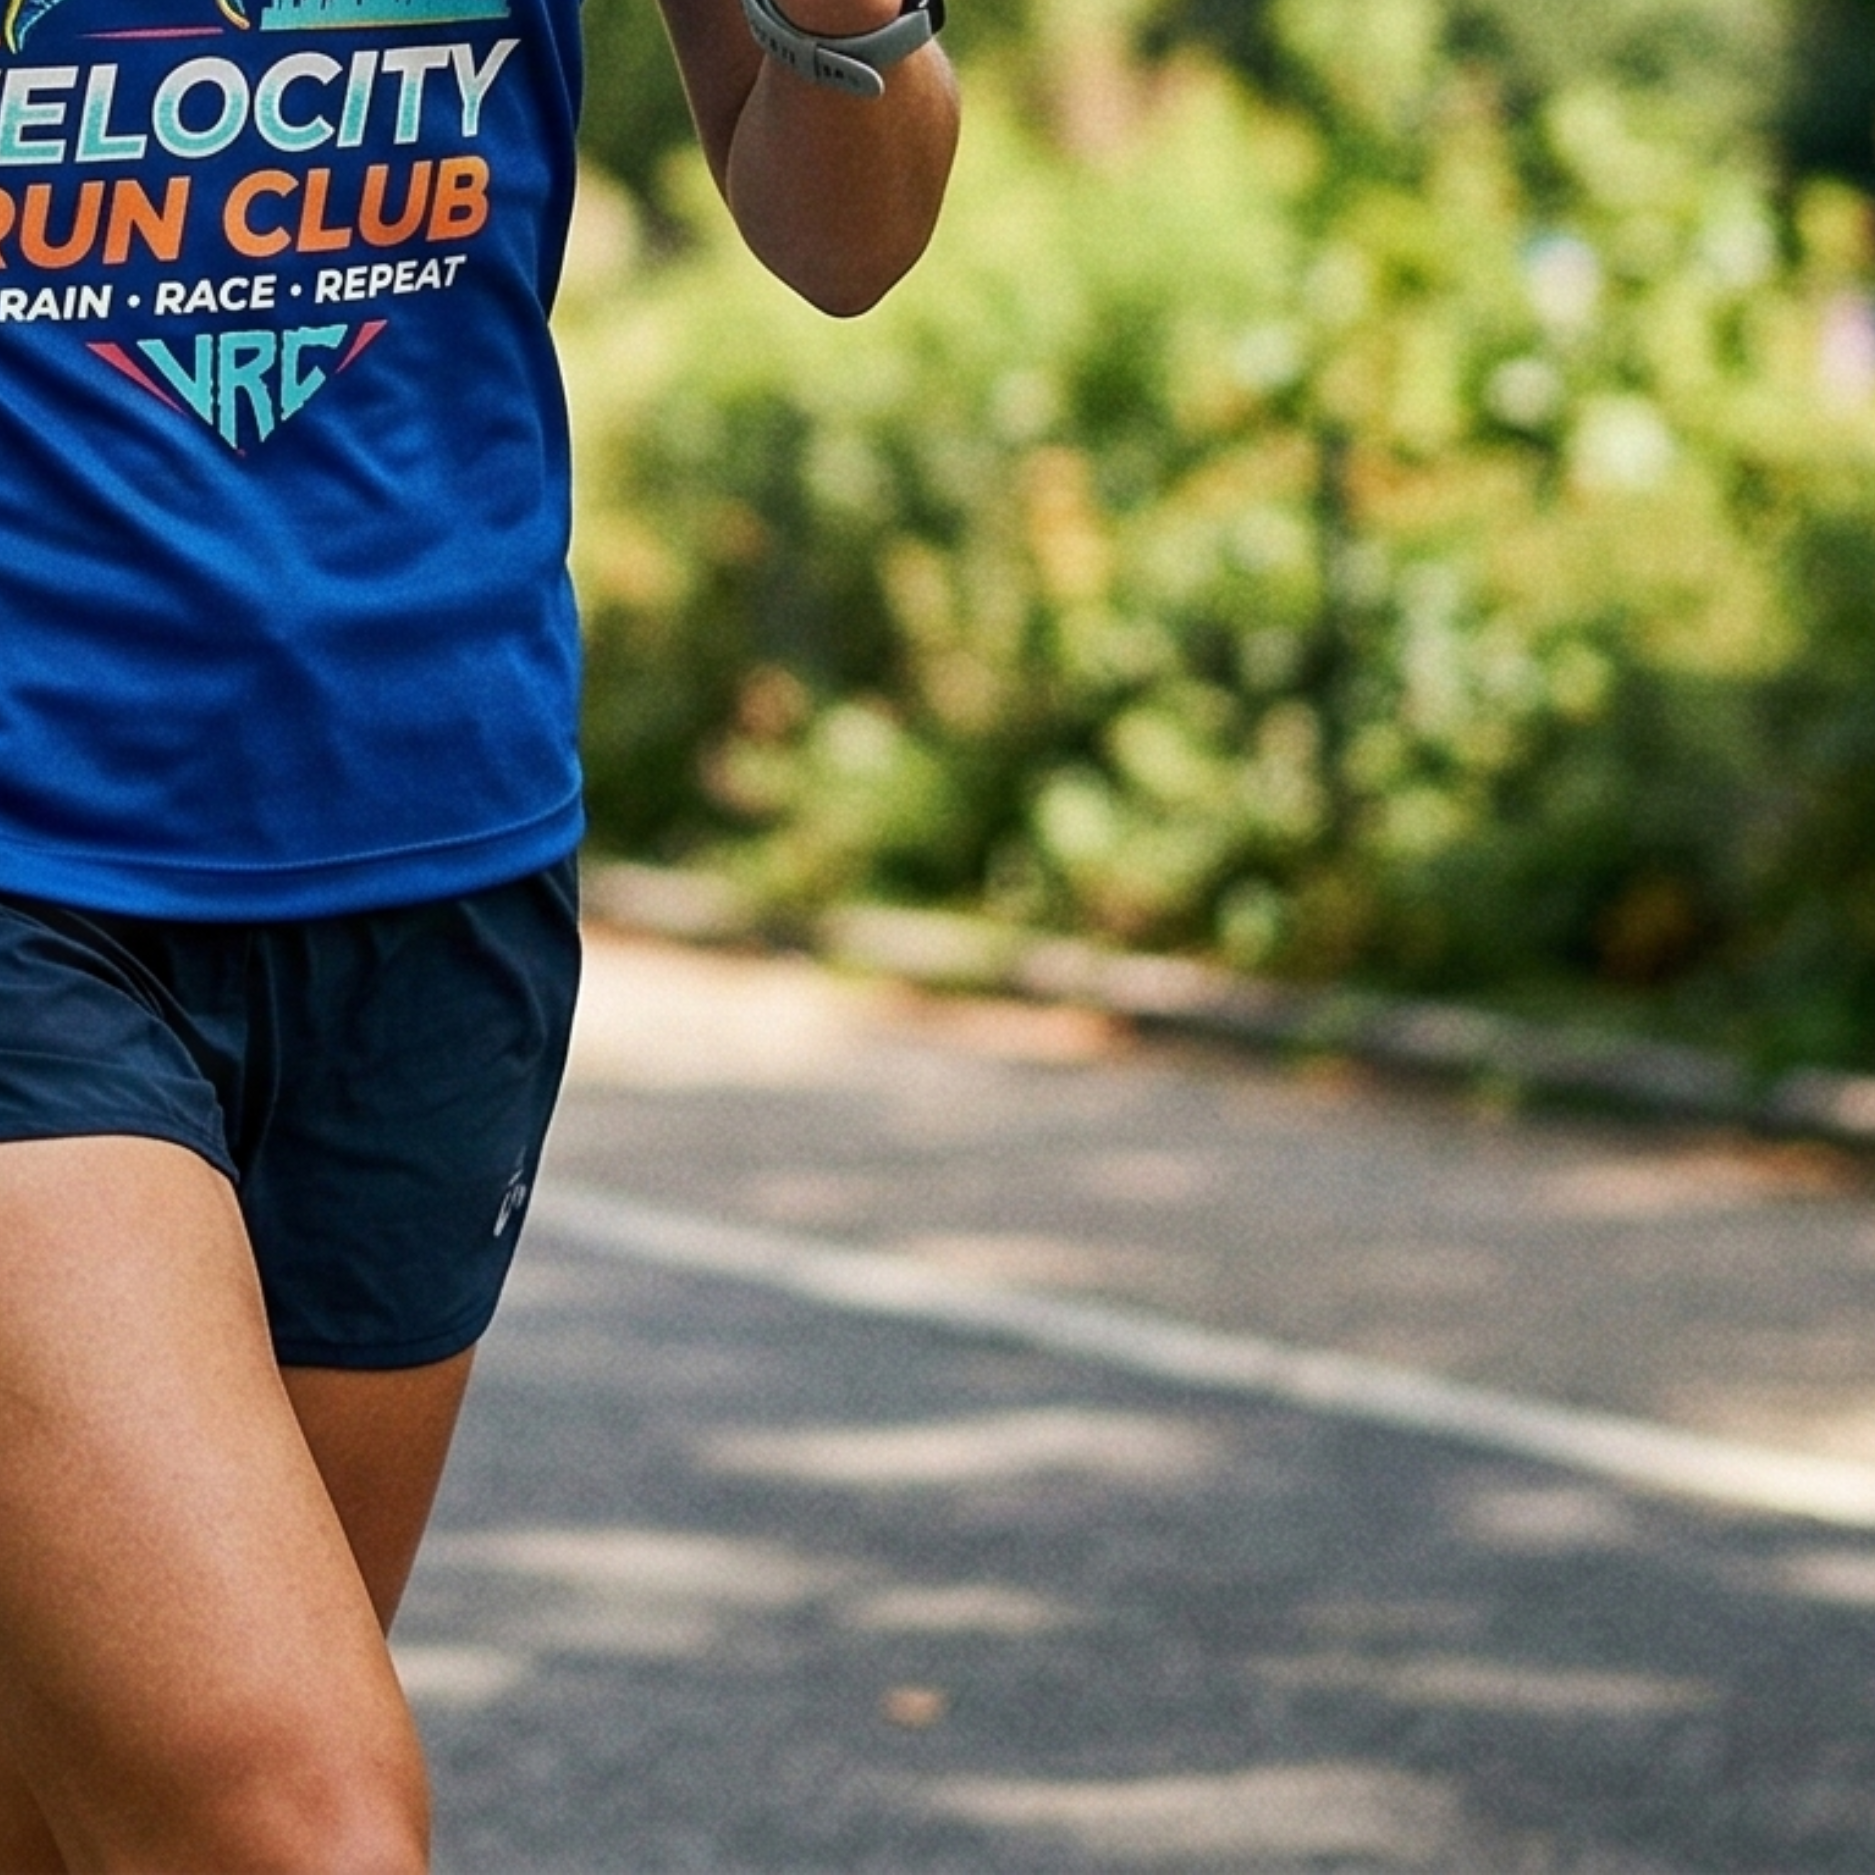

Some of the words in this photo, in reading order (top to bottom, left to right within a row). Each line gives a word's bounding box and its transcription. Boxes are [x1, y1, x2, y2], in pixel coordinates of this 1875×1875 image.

[223, 156, 489, 259] CLUB
[154, 274, 276, 316] RACE
[315, 255, 466, 304] REPEAT
[137, 324, 348, 451] VRC
